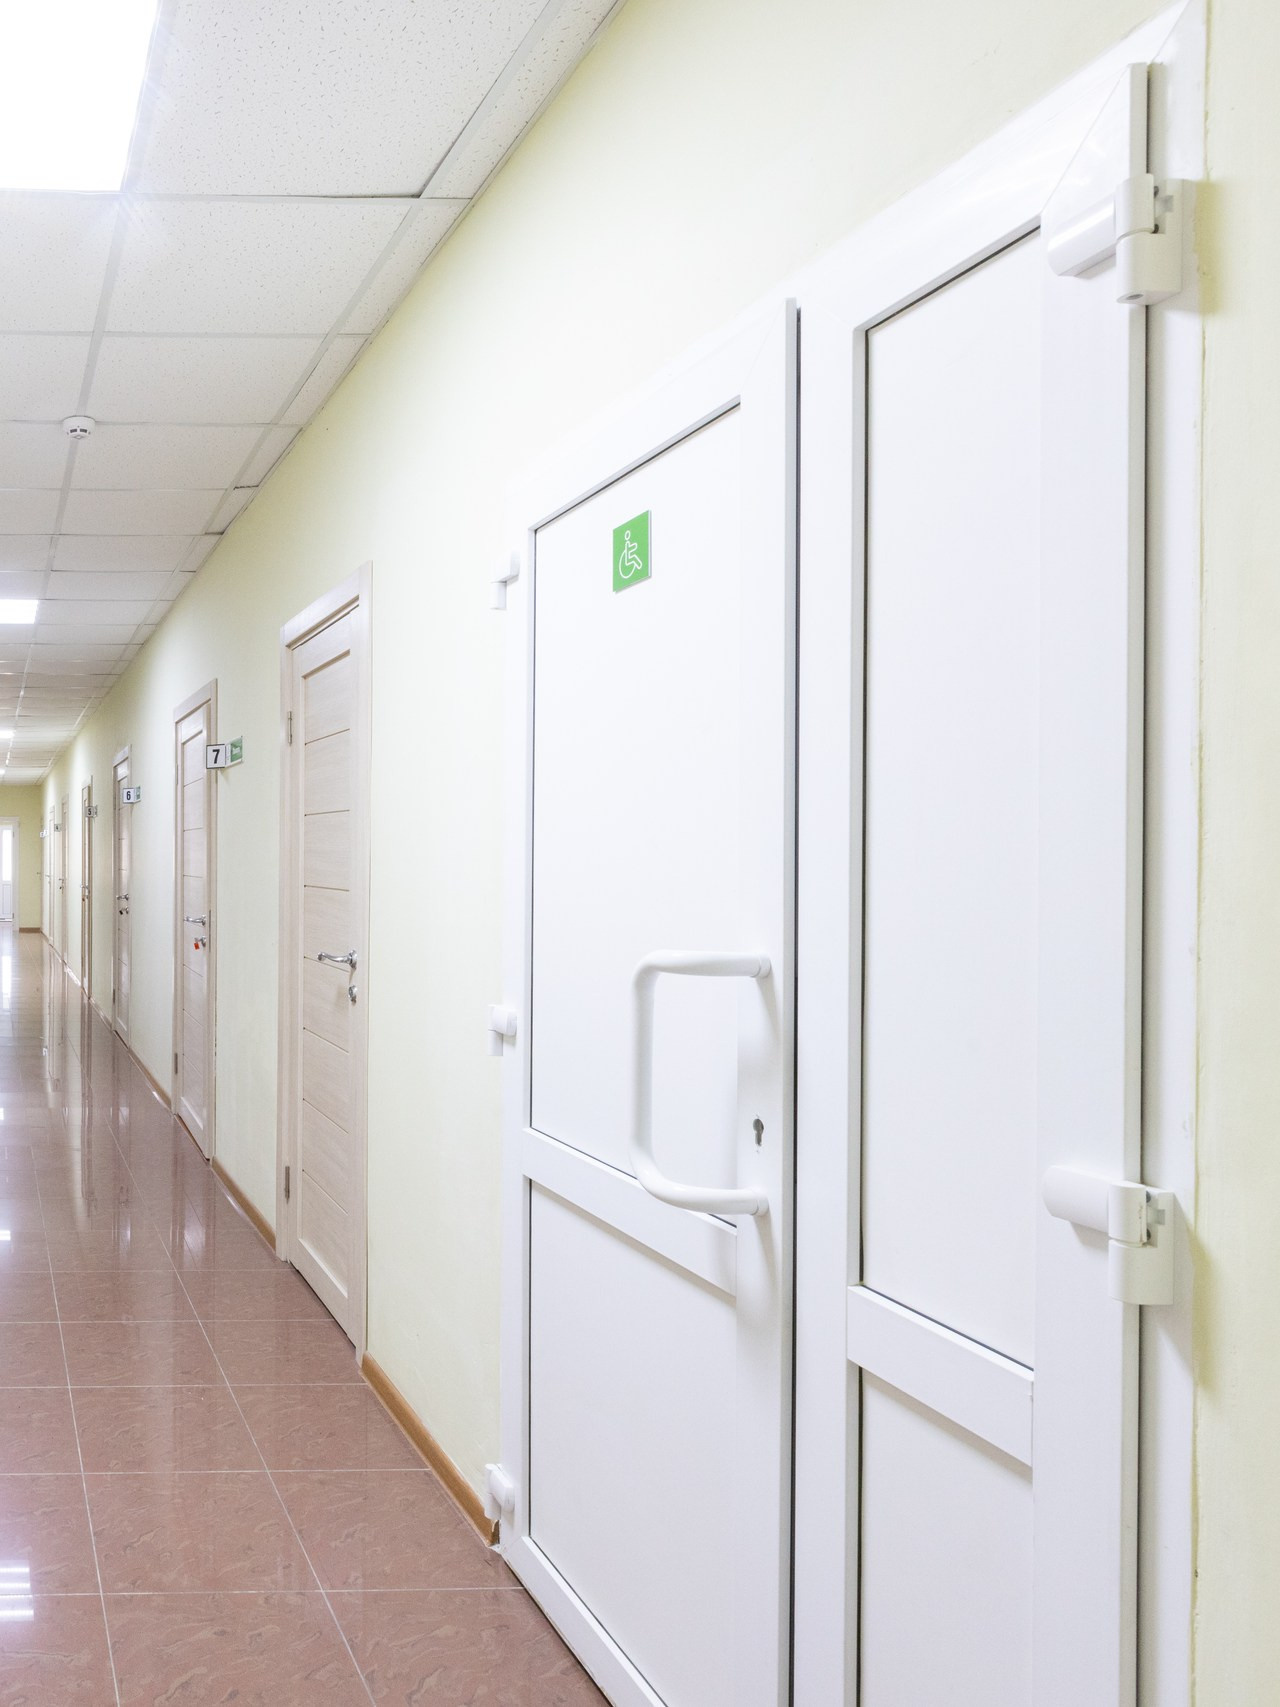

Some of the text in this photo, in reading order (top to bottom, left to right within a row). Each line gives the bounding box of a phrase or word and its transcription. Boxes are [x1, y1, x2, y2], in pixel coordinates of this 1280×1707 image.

[212, 748, 220, 764] 7
[126, 790, 132, 801] 6
[87, 808, 92, 816] 5
